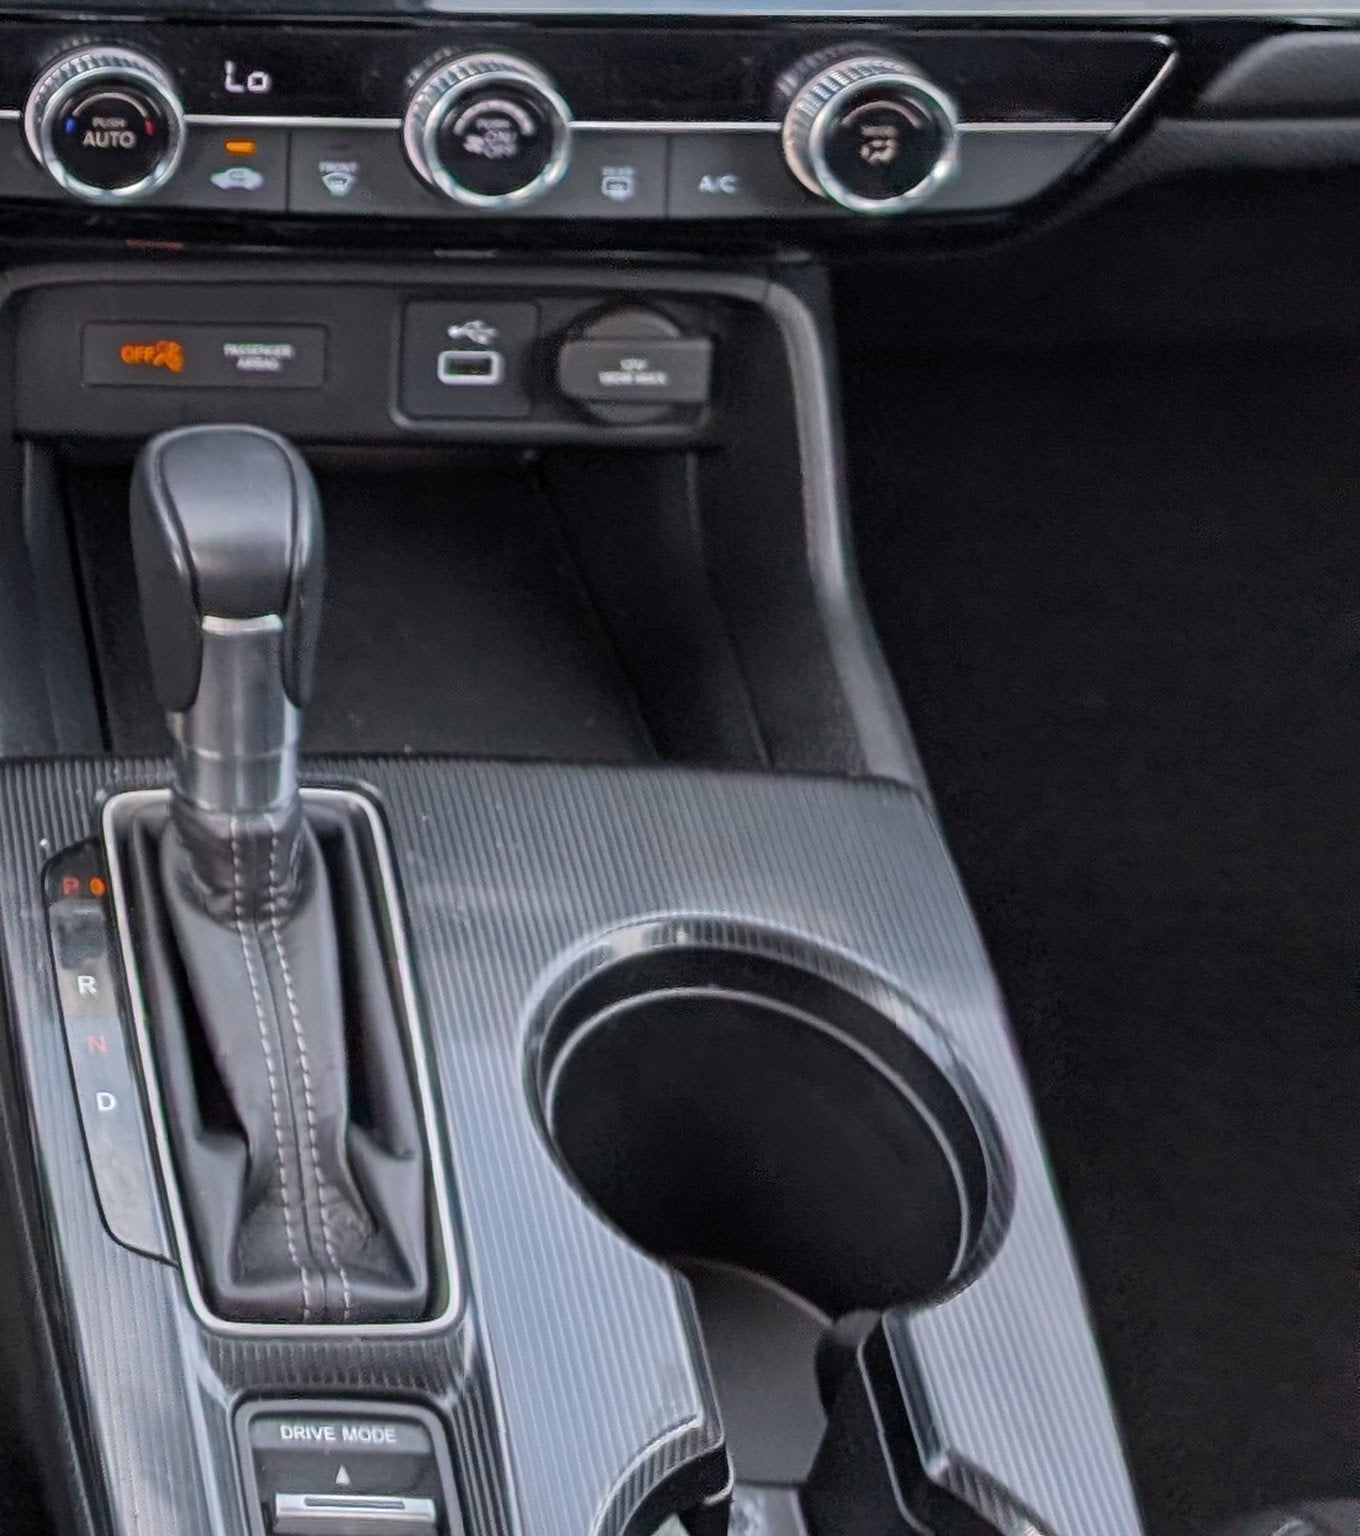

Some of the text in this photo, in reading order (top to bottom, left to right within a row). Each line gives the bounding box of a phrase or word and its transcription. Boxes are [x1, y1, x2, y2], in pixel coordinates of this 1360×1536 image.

[83, 130, 137, 149] AUTO
[61, 877, 80, 895] P
[77, 975, 97, 995] R
[86, 1035, 109, 1055] N
[96, 1092, 116, 1112] D
[280, 1424, 397, 1444] DRIVE MODE
